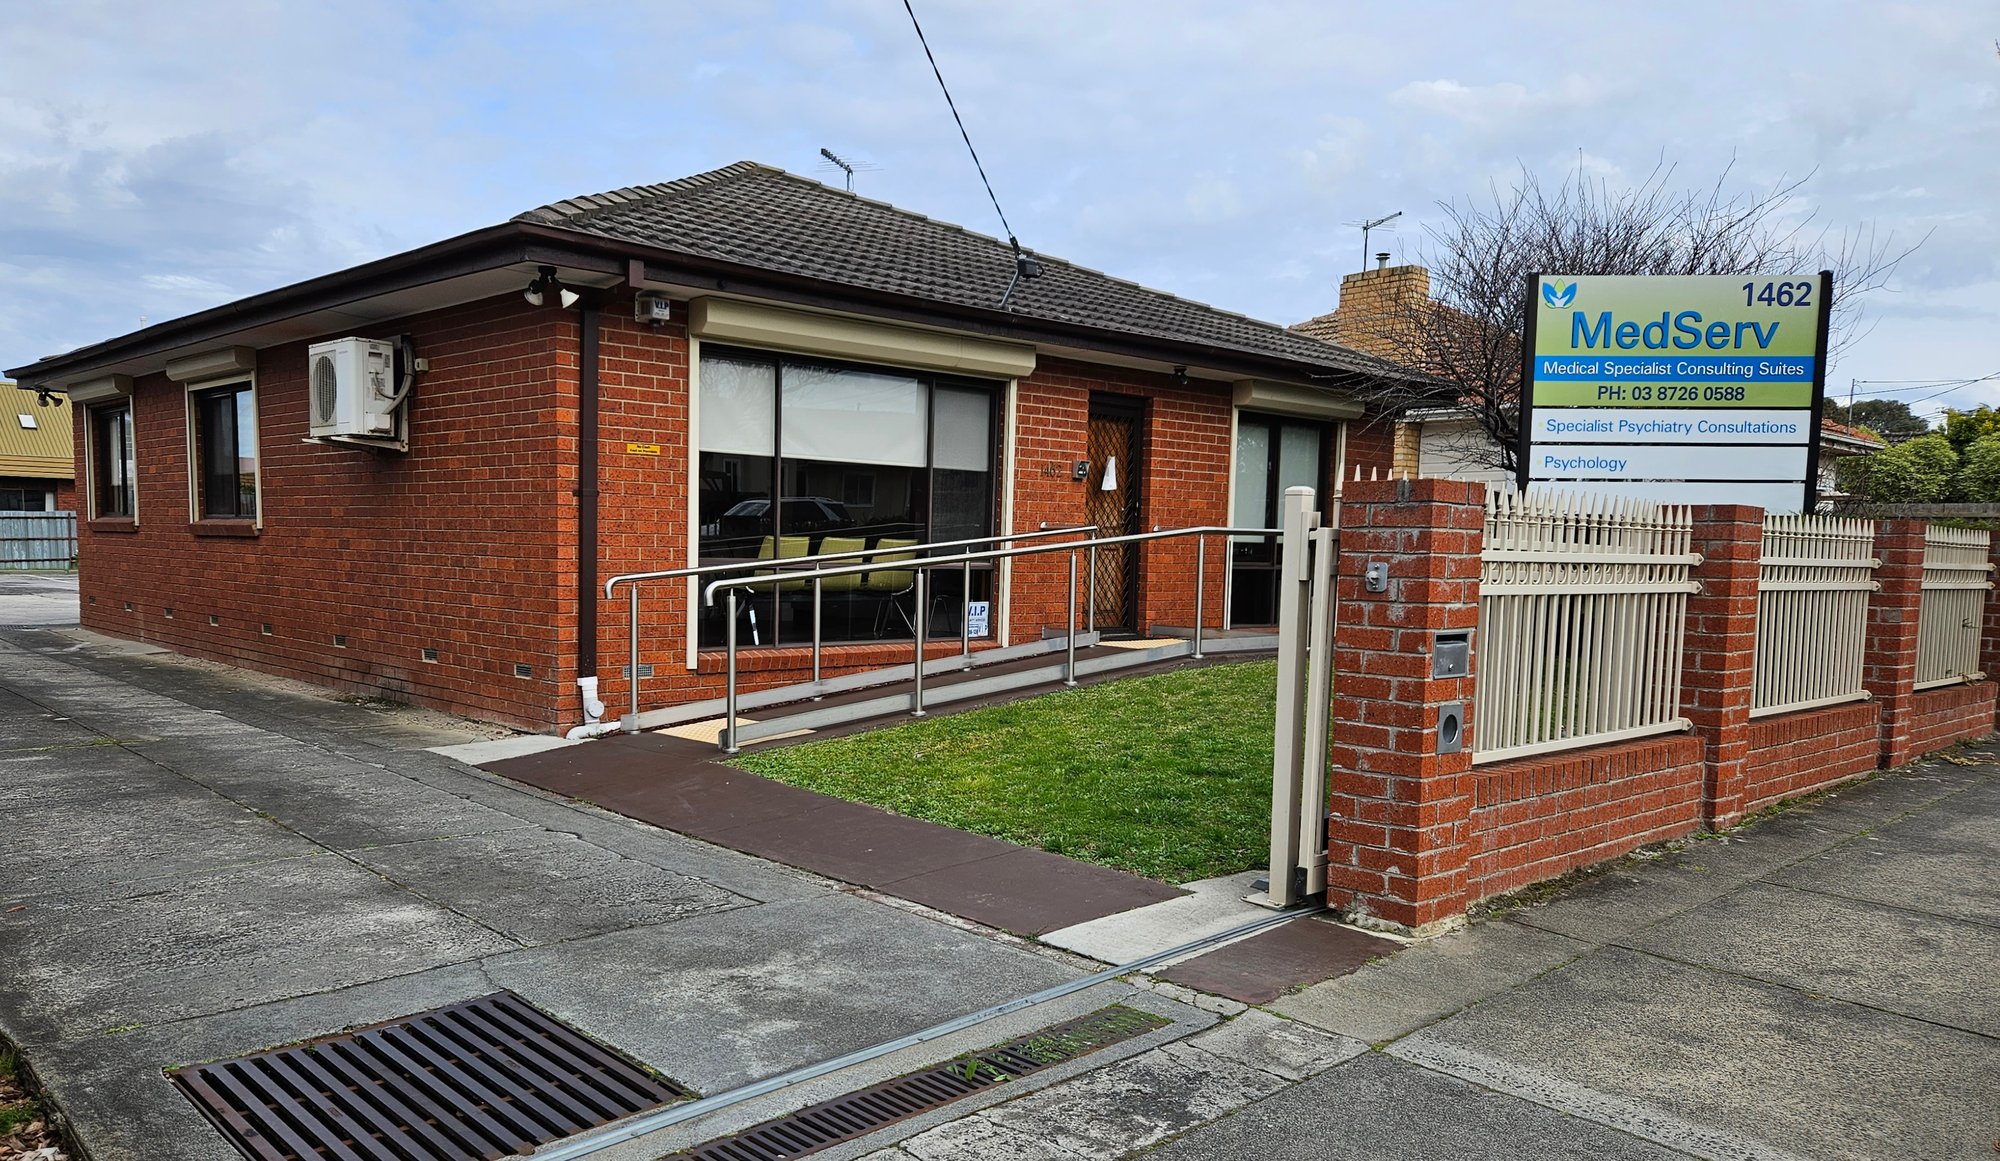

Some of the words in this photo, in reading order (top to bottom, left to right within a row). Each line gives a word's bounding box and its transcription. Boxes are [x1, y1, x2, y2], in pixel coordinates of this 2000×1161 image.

[1742, 281, 1813, 307] 1462
[1571, 311, 1780, 350] MedServ
[1543, 361, 1599, 375] Medical
[1604, 362, 1672, 378] Specialist
[1676, 362, 1754, 378] Consulting
[1759, 362, 1805, 376] Suites
[1597, 385, 1627, 400] PH:
[1631, 386, 1652, 401] 03
[1657, 386, 1699, 401] 8726
[1703, 387, 1745, 401] 0588
[1546, 419, 1613, 435] Specialist
[1619, 419, 1692, 435] Psychiatry
[1697, 420, 1797, 435] Consultations
[1040, 461, 1062, 478] 1462
[1544, 456, 1628, 472] Psychology
